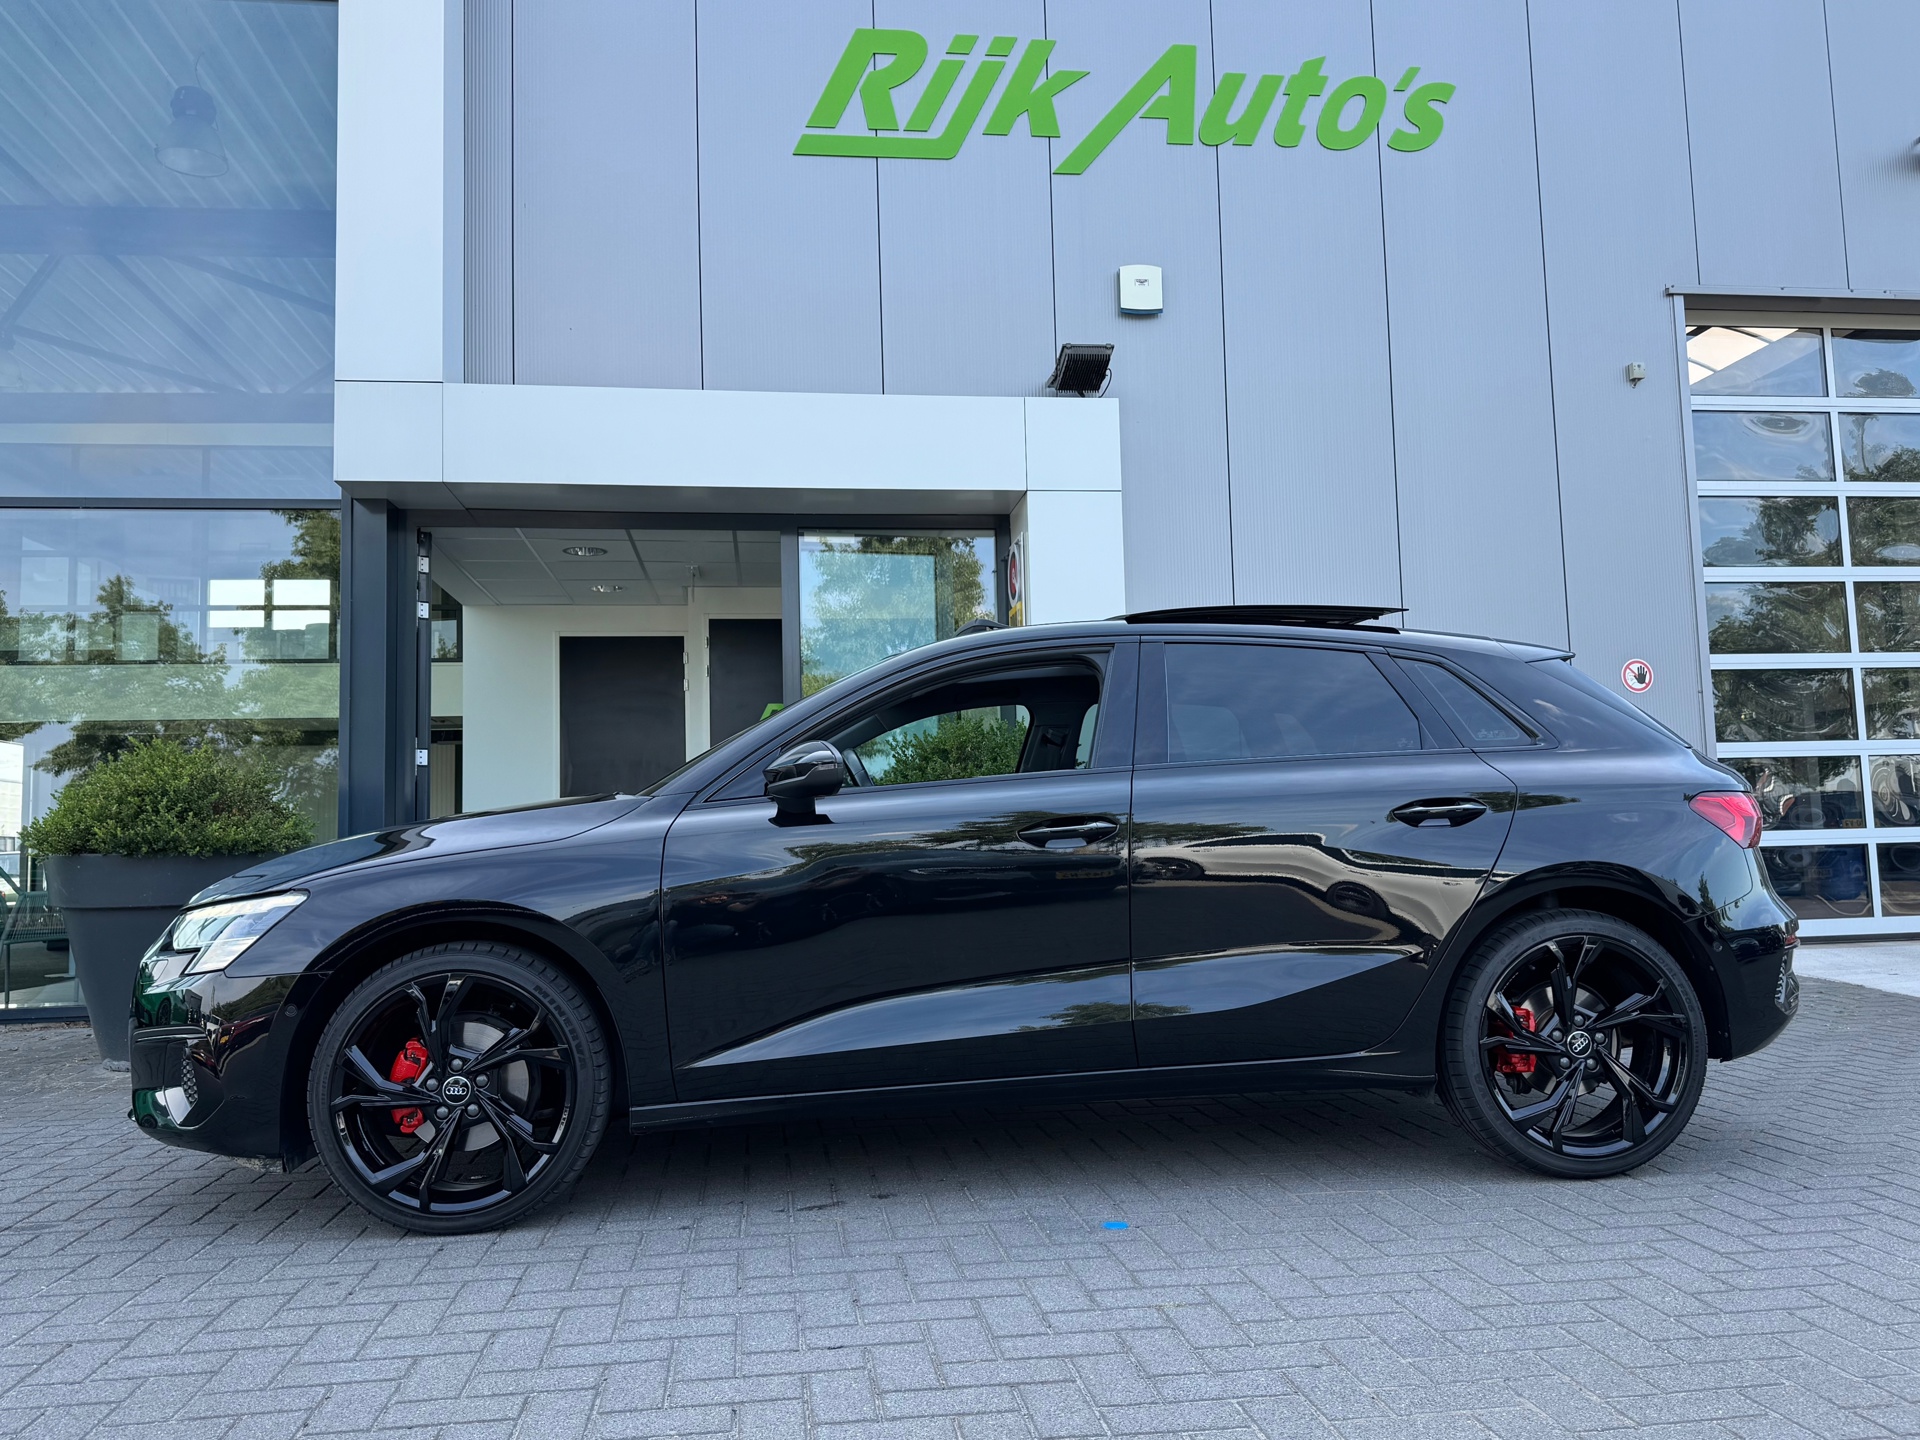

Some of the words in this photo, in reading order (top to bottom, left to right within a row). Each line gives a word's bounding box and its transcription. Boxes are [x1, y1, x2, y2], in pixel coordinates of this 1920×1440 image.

[793, 28, 1091, 160] Rijk
[1052, 43, 1457, 176] Auto's
[532, 984, 588, 1072] MINERVA
